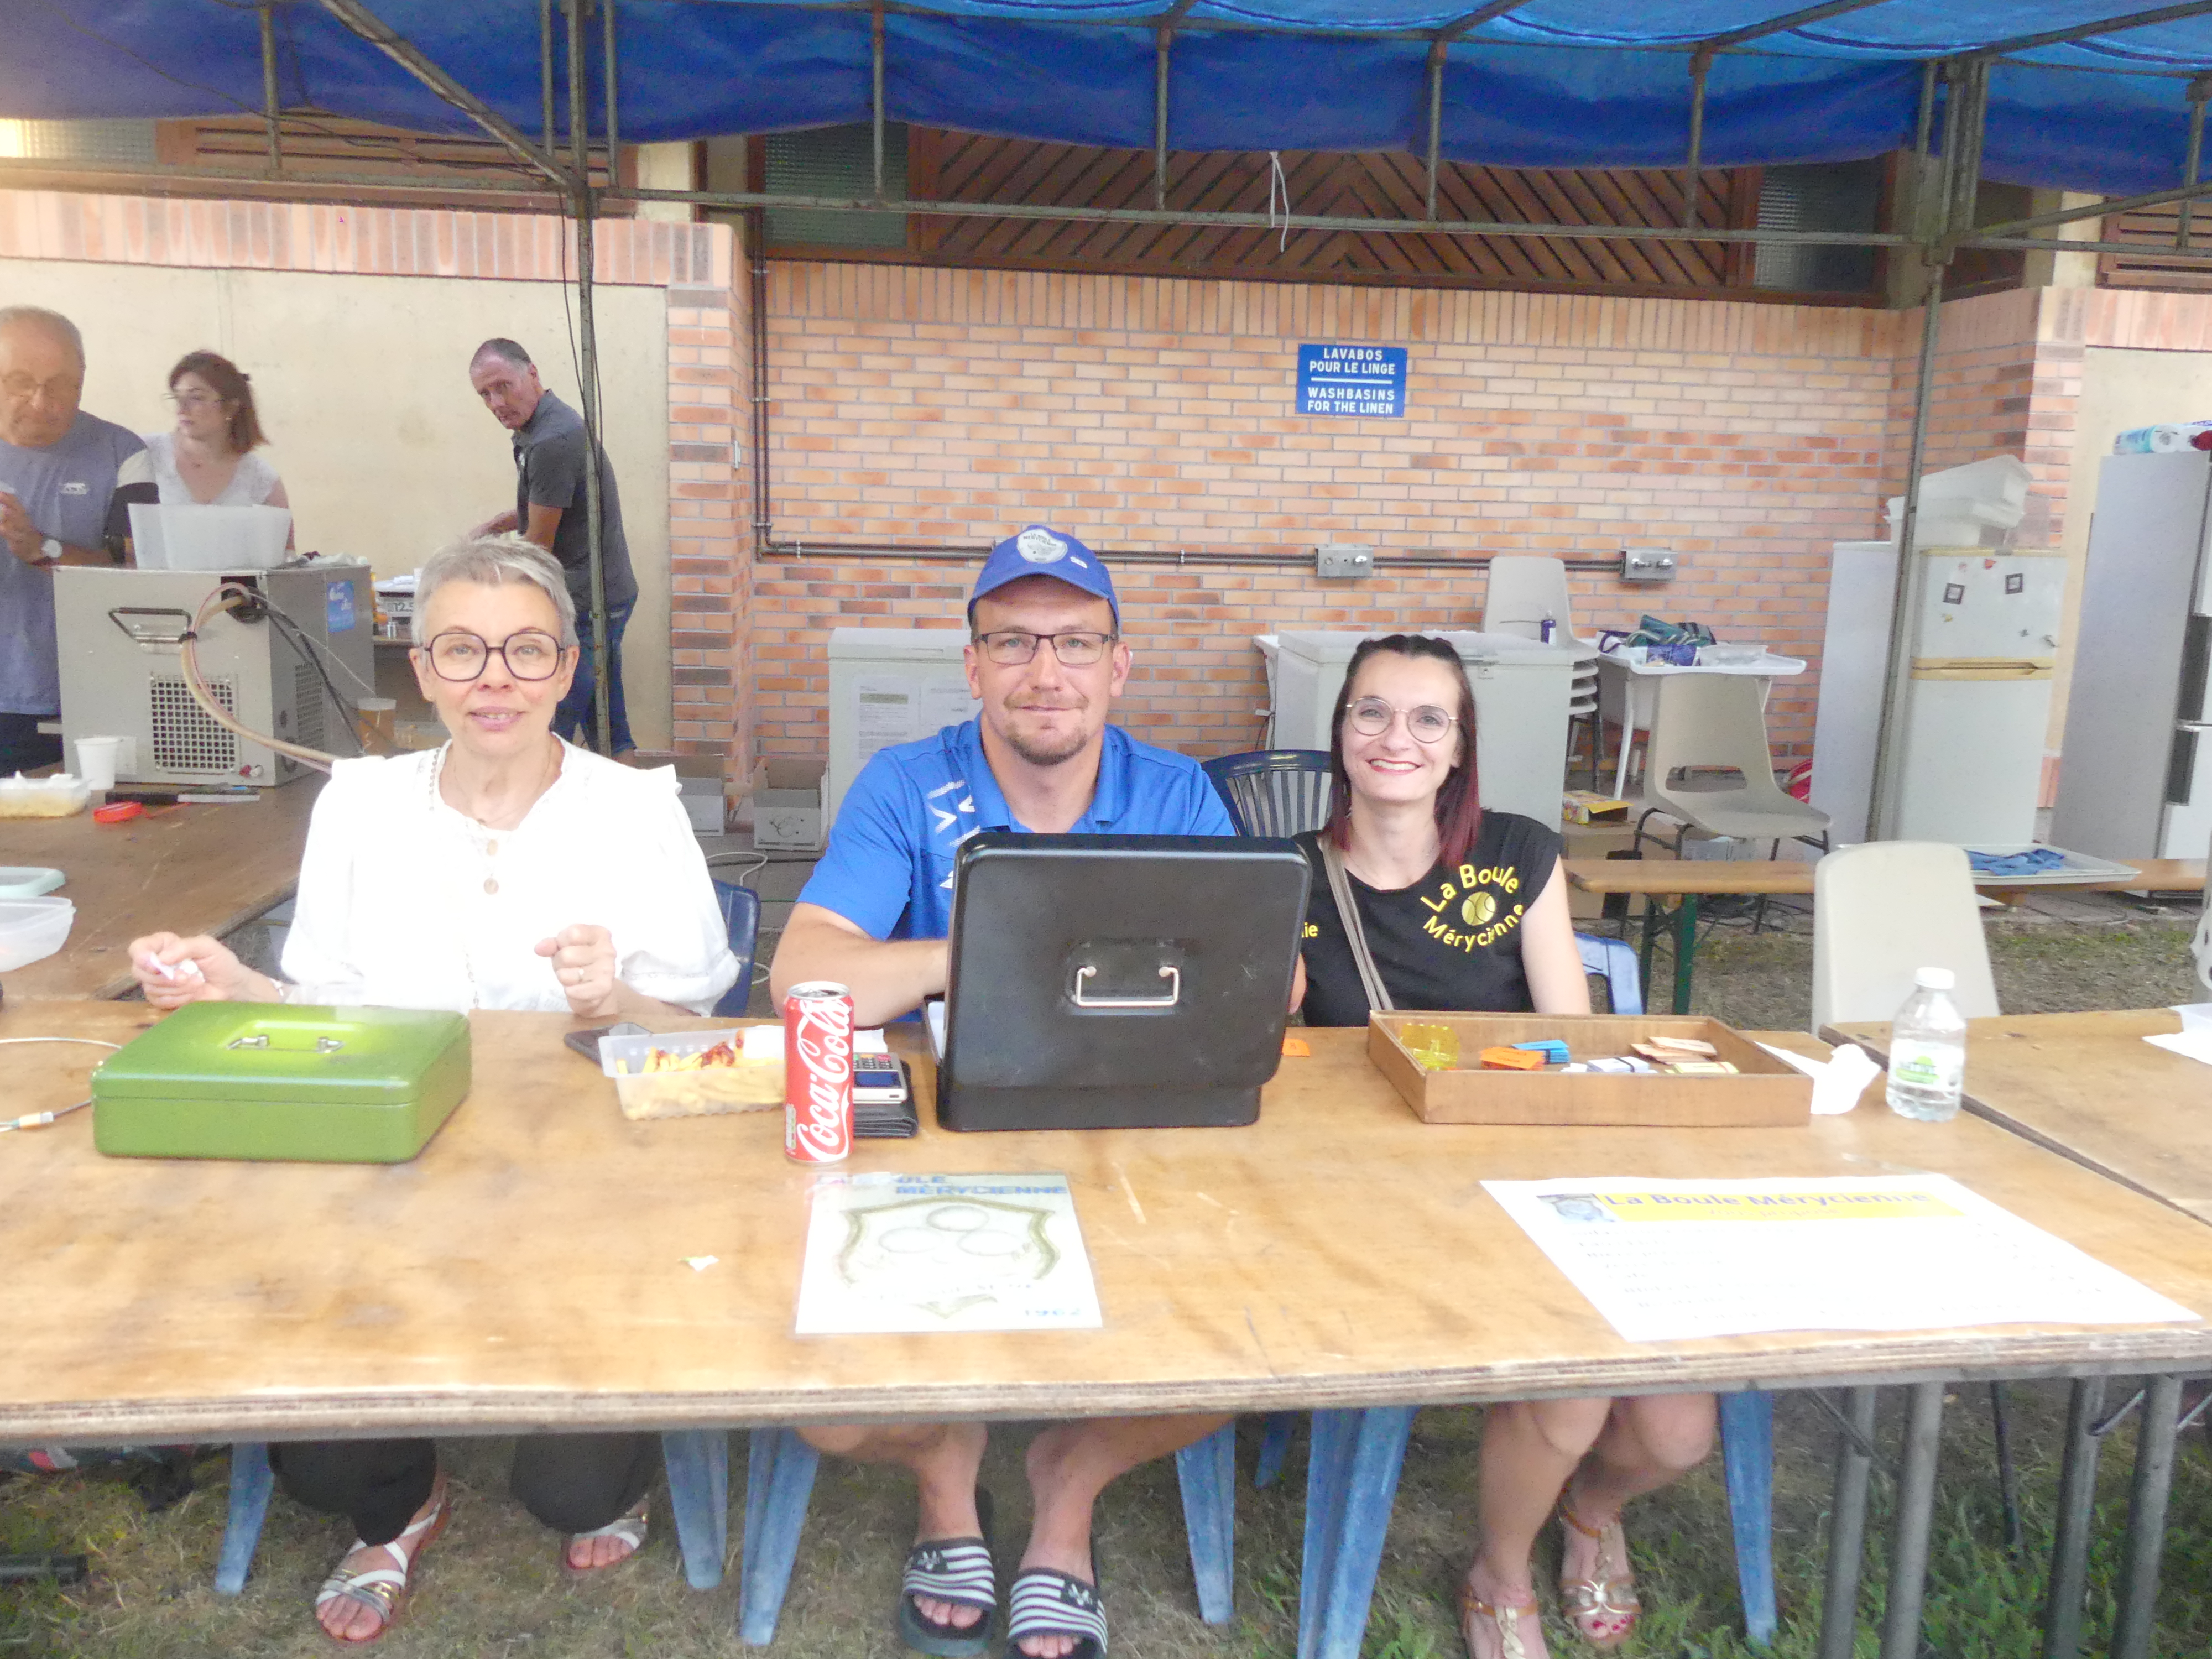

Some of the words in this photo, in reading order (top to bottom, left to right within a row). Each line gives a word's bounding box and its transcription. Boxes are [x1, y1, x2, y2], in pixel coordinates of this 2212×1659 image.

[1324, 348, 1383, 360] LAVABOS
[1310, 361, 1340, 373] POUR
[1344, 362, 1358, 373] LE
[1361, 363, 1395, 375] LINGE
[1307, 387, 1395, 401] WASHBASINS
[1307, 400, 1330, 411] FOR
[1334, 401, 1356, 413] THE
[1359, 403, 1394, 414] LINEN
[1420, 883, 1458, 912] La
[1459, 864, 1519, 894] Boule
[797, 998, 851, 1161] Coca-Cola
[1604, 1195, 1644, 1206] La
[1650, 1194, 1741, 1206] Boule
[1745, 1193, 1930, 1206] Mérycienne
